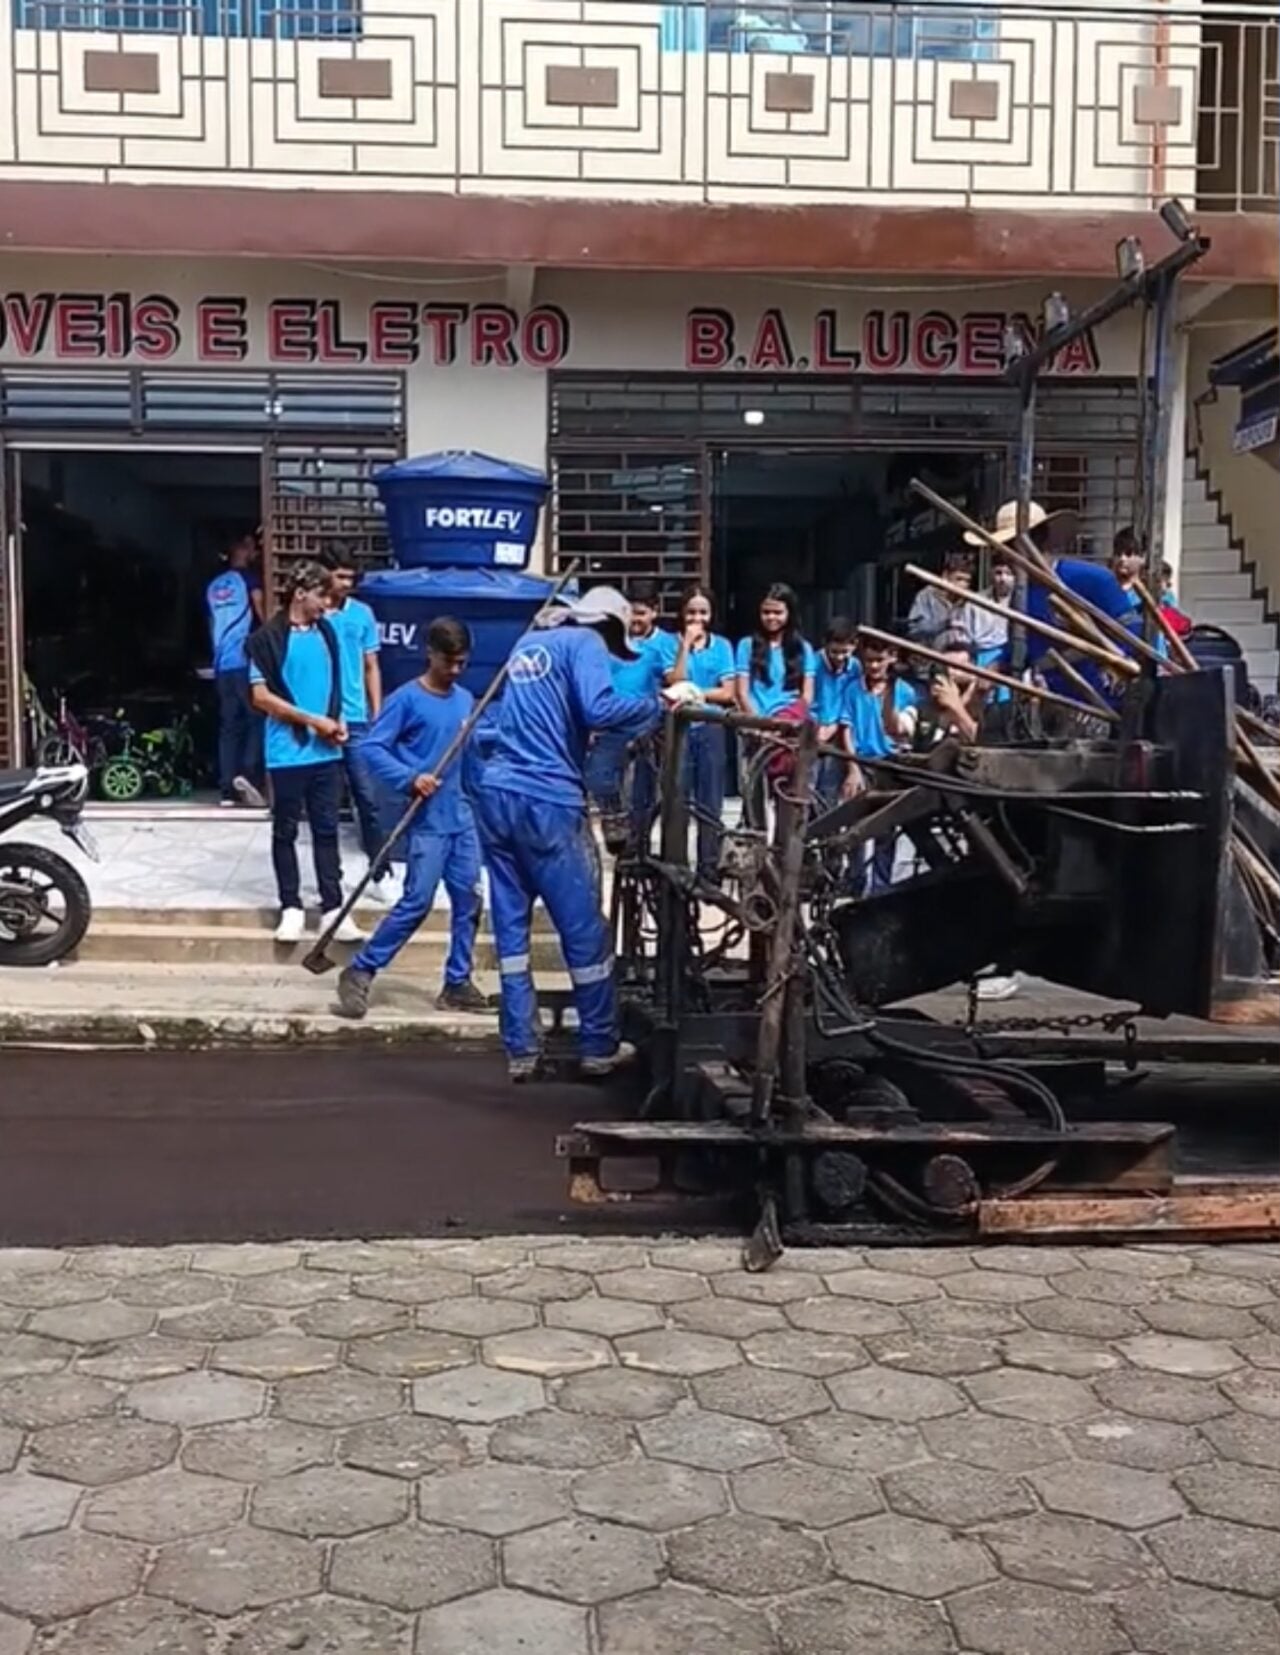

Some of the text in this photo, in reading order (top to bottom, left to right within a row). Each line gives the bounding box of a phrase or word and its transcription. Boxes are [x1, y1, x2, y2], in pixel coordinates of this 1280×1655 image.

[0, 292, 569, 367] VEIS E ELETRO
[425, 507, 522, 530] FORTLEV
